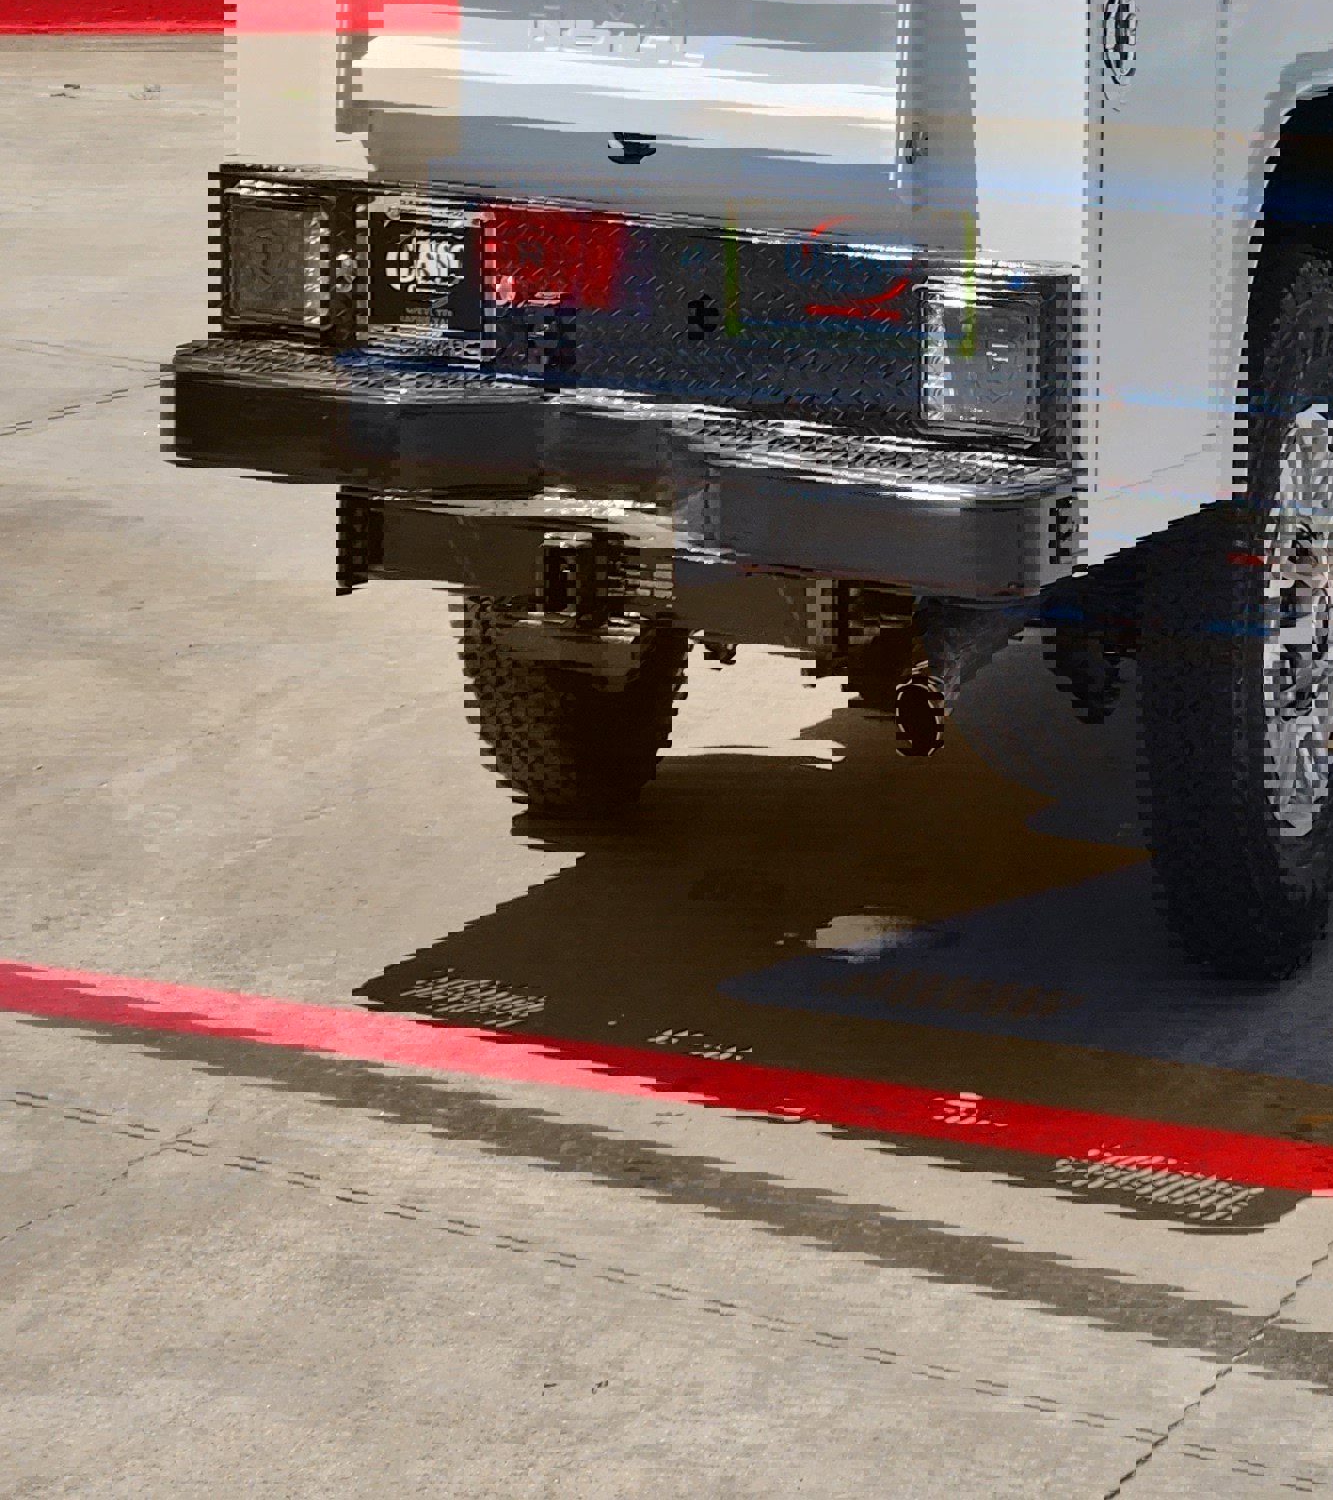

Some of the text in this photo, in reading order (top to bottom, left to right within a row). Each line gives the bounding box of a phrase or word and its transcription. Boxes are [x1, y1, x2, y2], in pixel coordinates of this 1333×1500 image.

[870, 204, 912, 217] TEXAS
[517, 240, 545, 269] R
[785, 233, 920, 283] CLASSIC
[823, 276, 885, 295] Chevrolet
[868, 308, 902, 321] TEXAS
